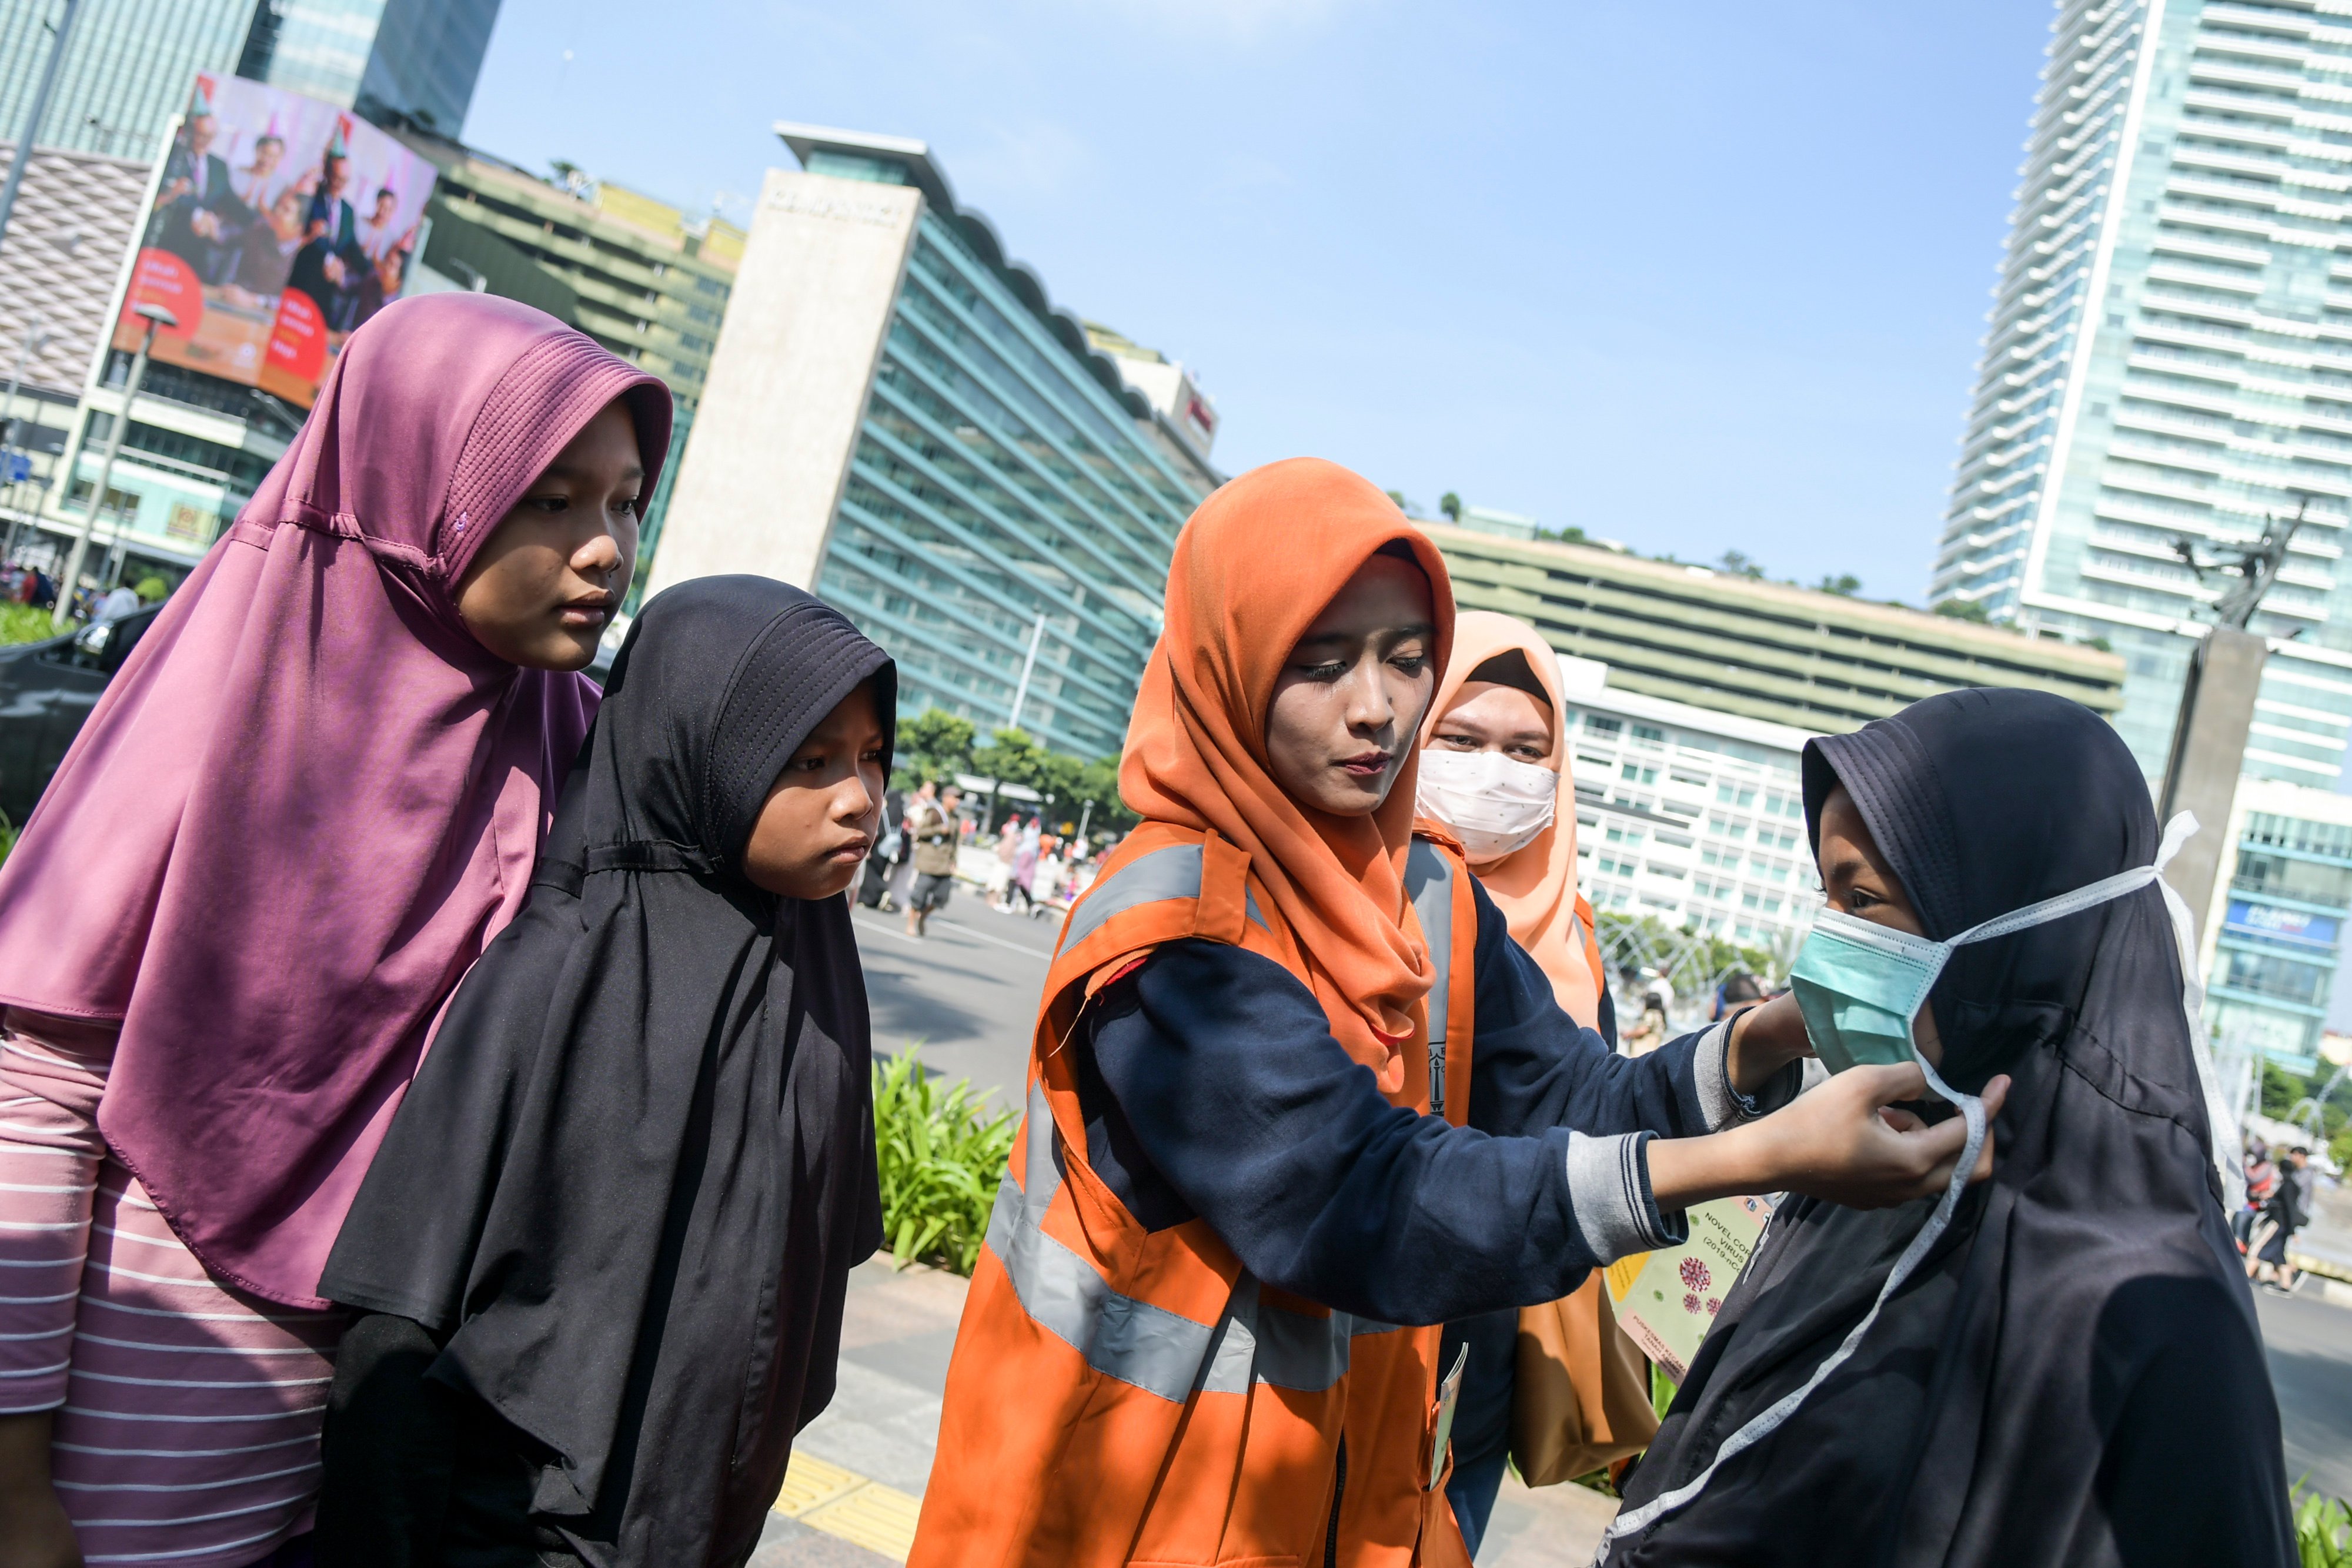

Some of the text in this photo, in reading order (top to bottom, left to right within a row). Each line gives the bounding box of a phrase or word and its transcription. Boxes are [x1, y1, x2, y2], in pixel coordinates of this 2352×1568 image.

[1705, 1212, 1730, 1240] NOVEL
[1720, 1238, 1745, 1263] VIRUS
[1633, 1316, 1665, 1349] PUSKESMAS
[1645, 1334, 1680, 1373] TANAH ABANG
